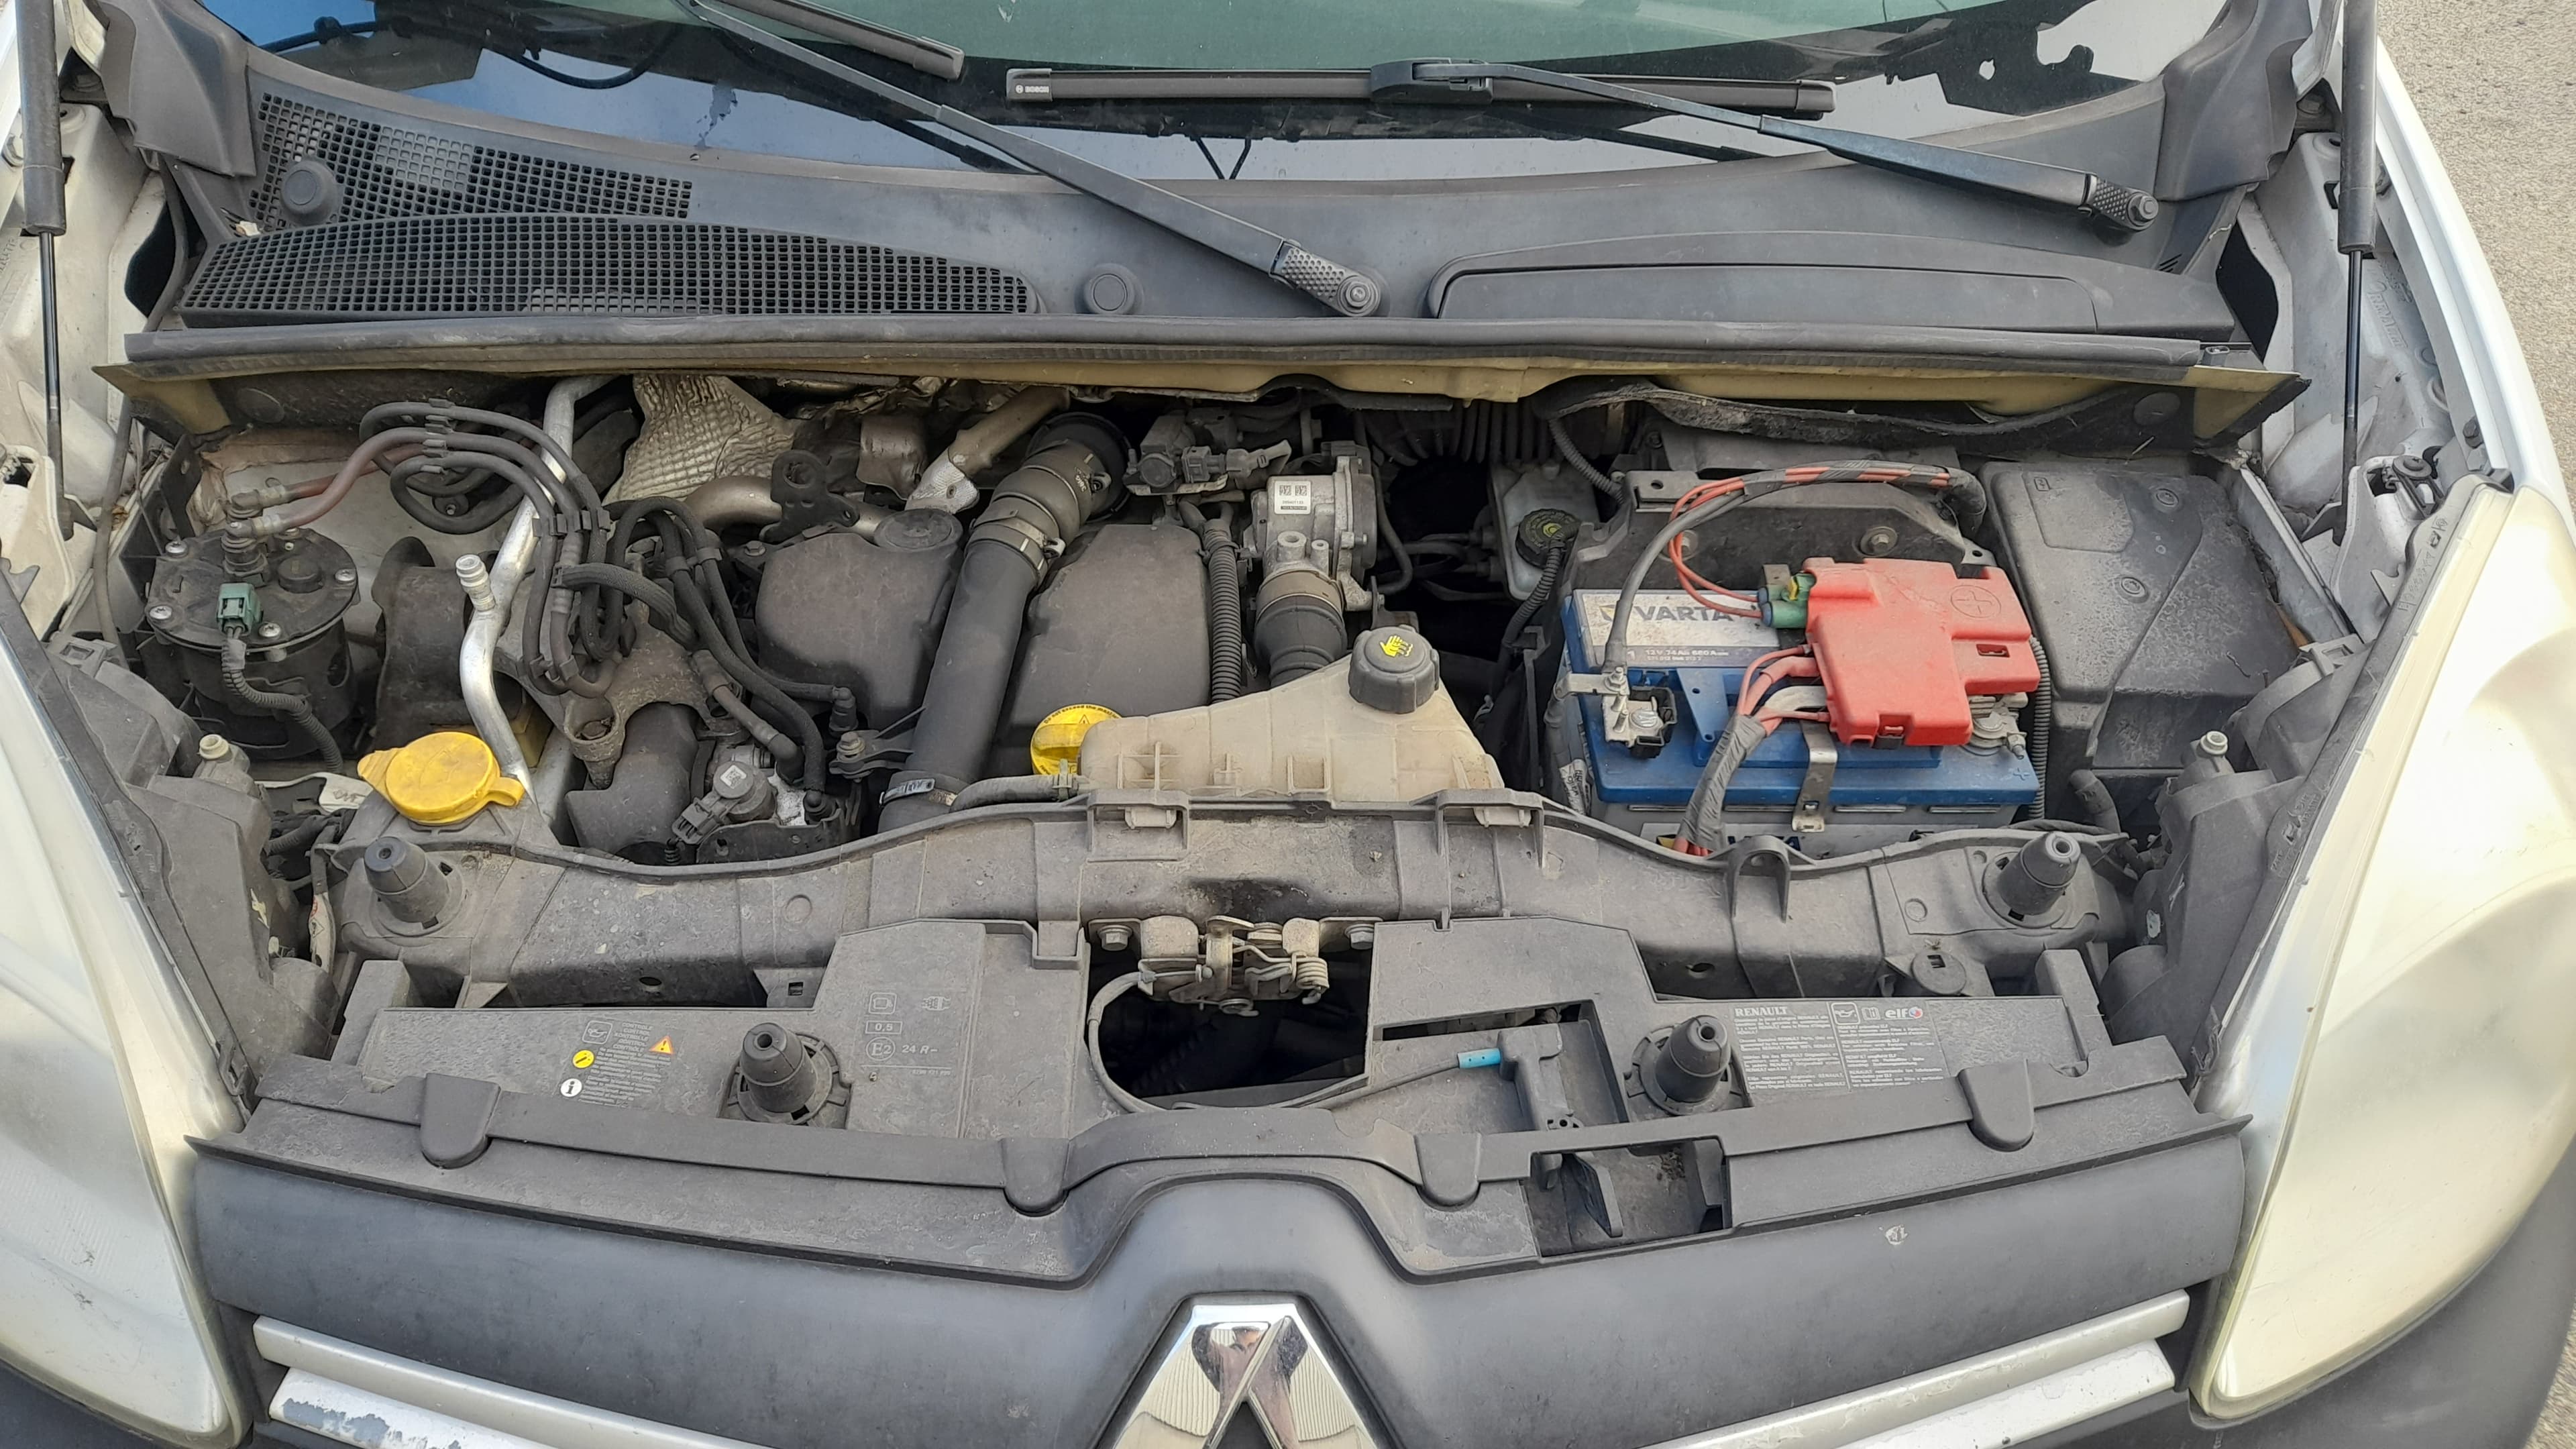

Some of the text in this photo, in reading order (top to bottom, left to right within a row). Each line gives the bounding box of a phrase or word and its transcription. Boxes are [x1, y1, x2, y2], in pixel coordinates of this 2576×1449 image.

[1634, 606, 1734, 621] VARTA
[1735, 1007, 1787, 1016] RENAULT
[1885, 1008, 1909, 1018] elf
[875, 1023, 893, 1032] 0,5
[871, 1042, 892, 1056] E2
[902, 1044, 916, 1053] 24
